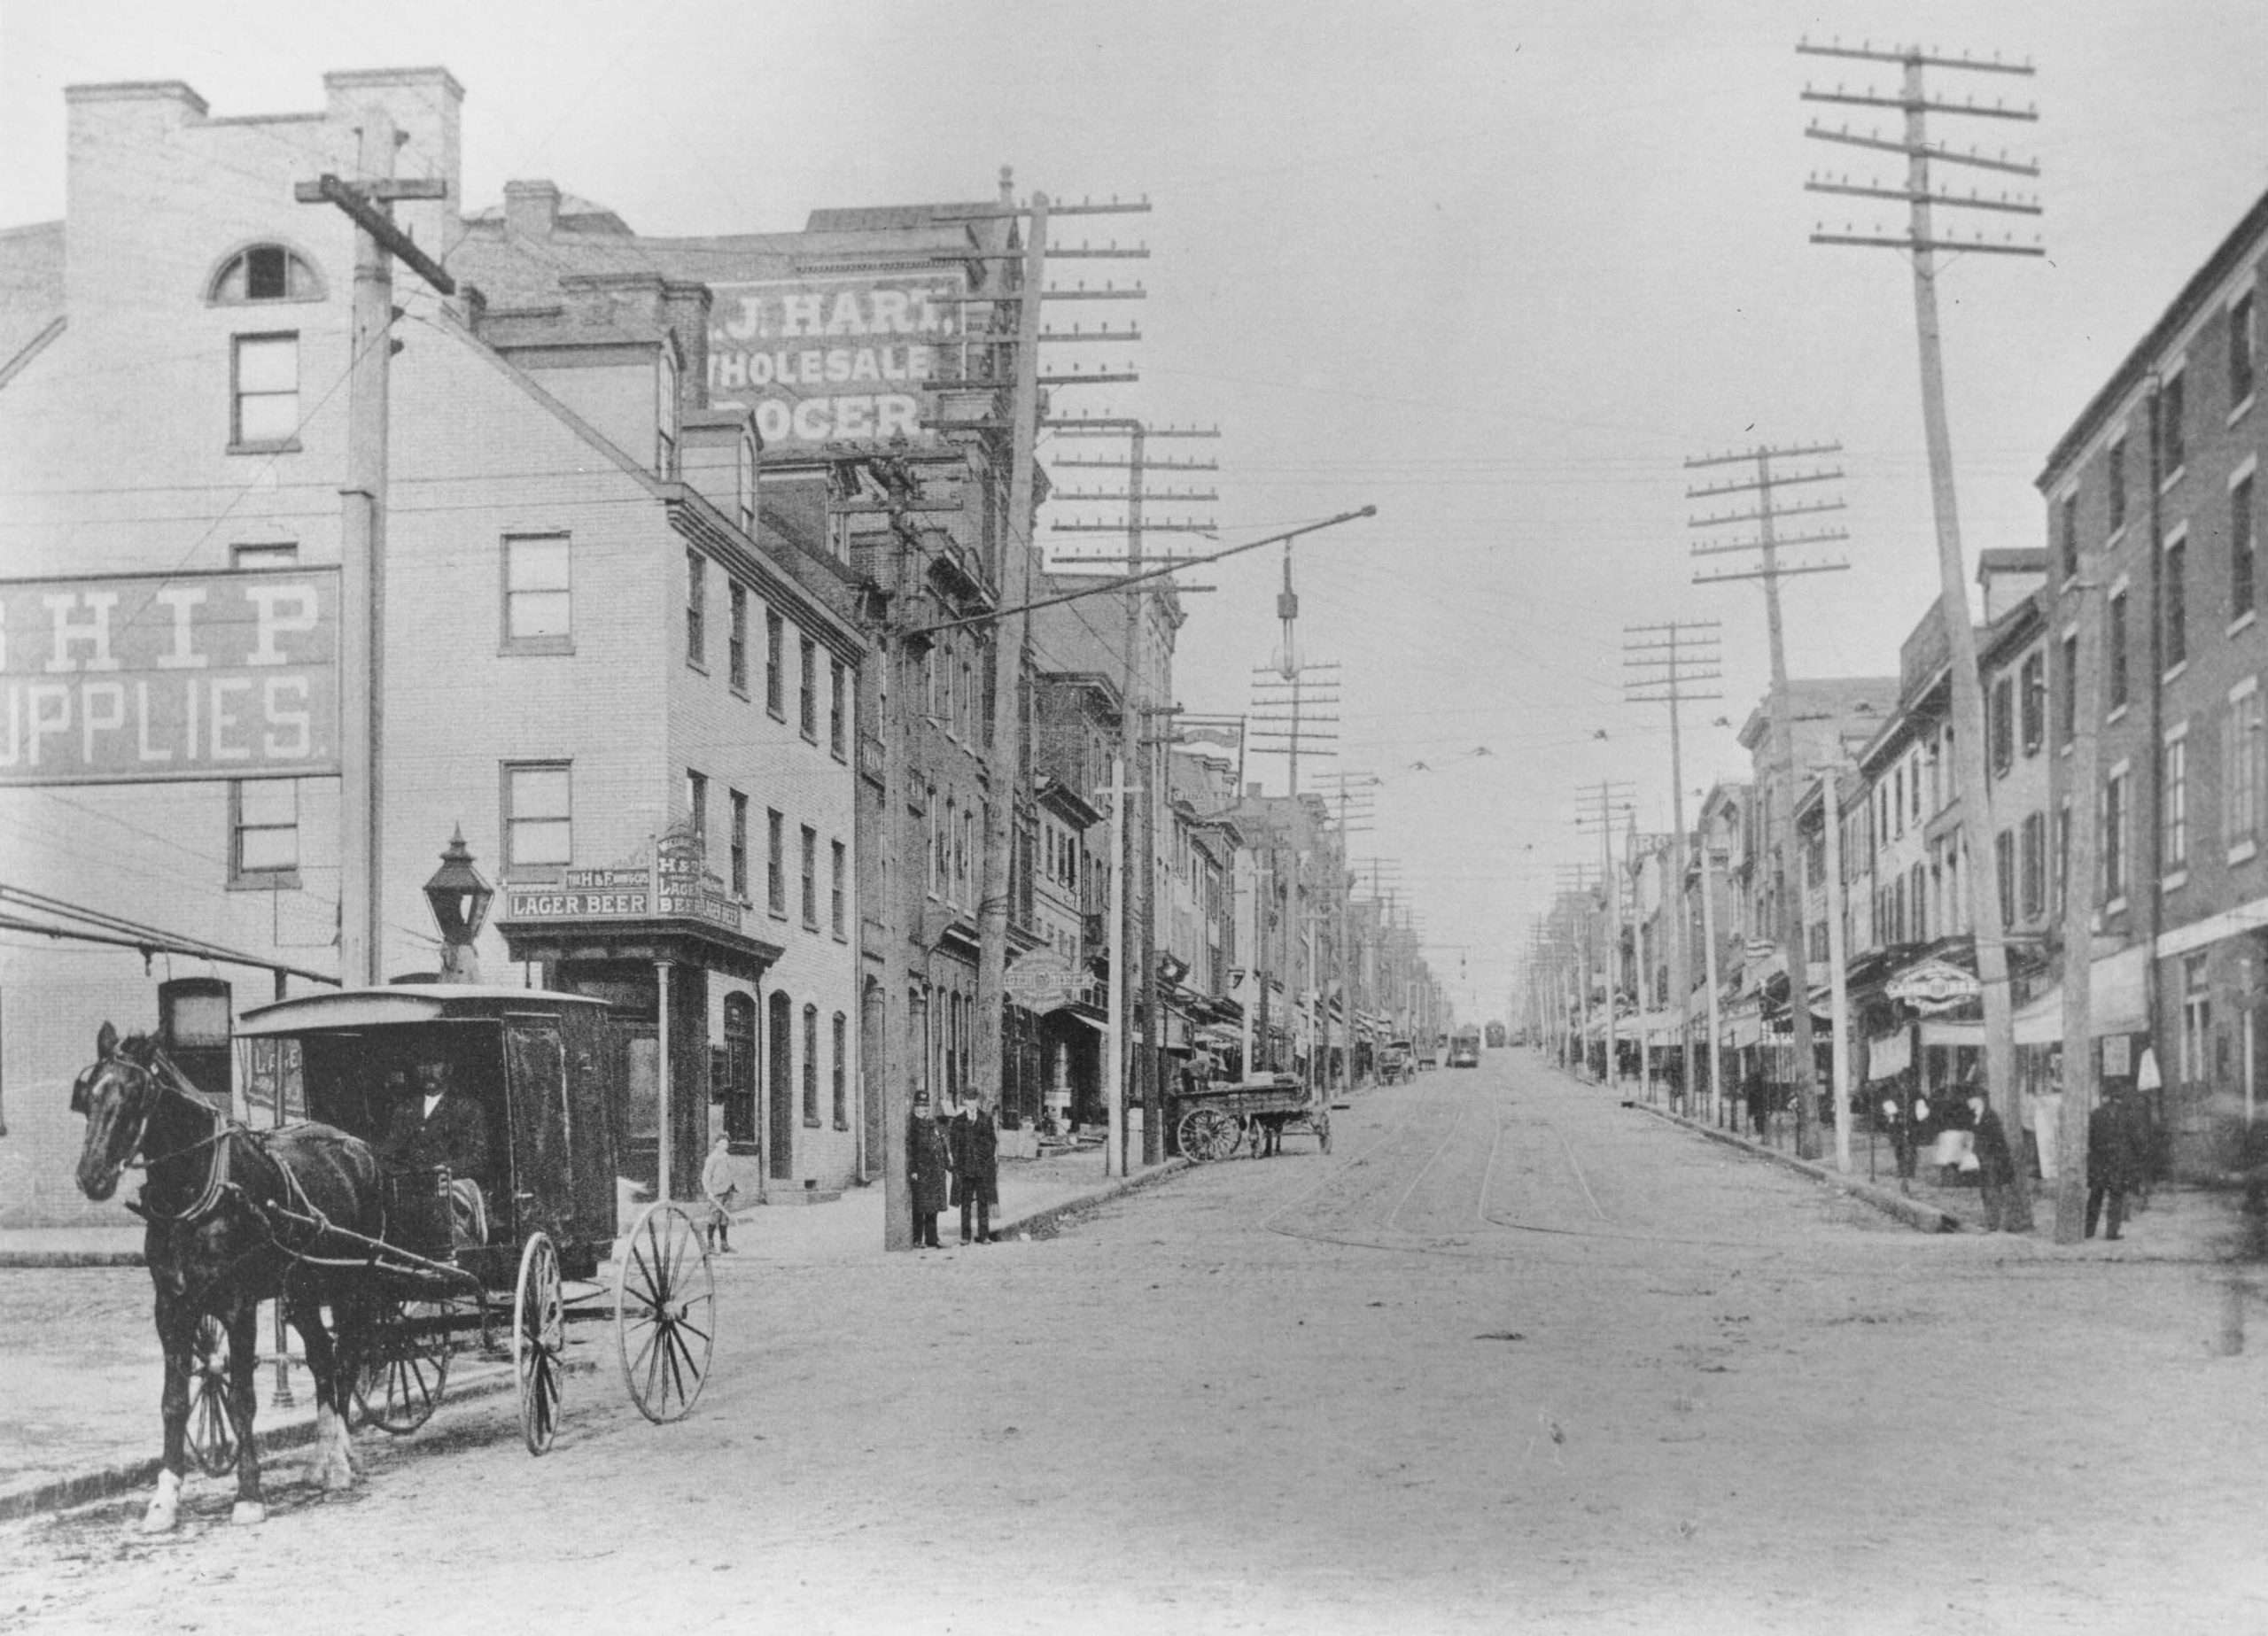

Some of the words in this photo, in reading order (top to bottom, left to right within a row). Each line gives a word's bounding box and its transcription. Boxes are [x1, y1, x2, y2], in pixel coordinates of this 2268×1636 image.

[710, 345, 930, 387] HOLESALE
[714, 395, 919, 441] OCER
[0, 585, 318, 673] HIP
[513, 896, 579, 915] LAGER
[586, 895, 647, 914] BEER
